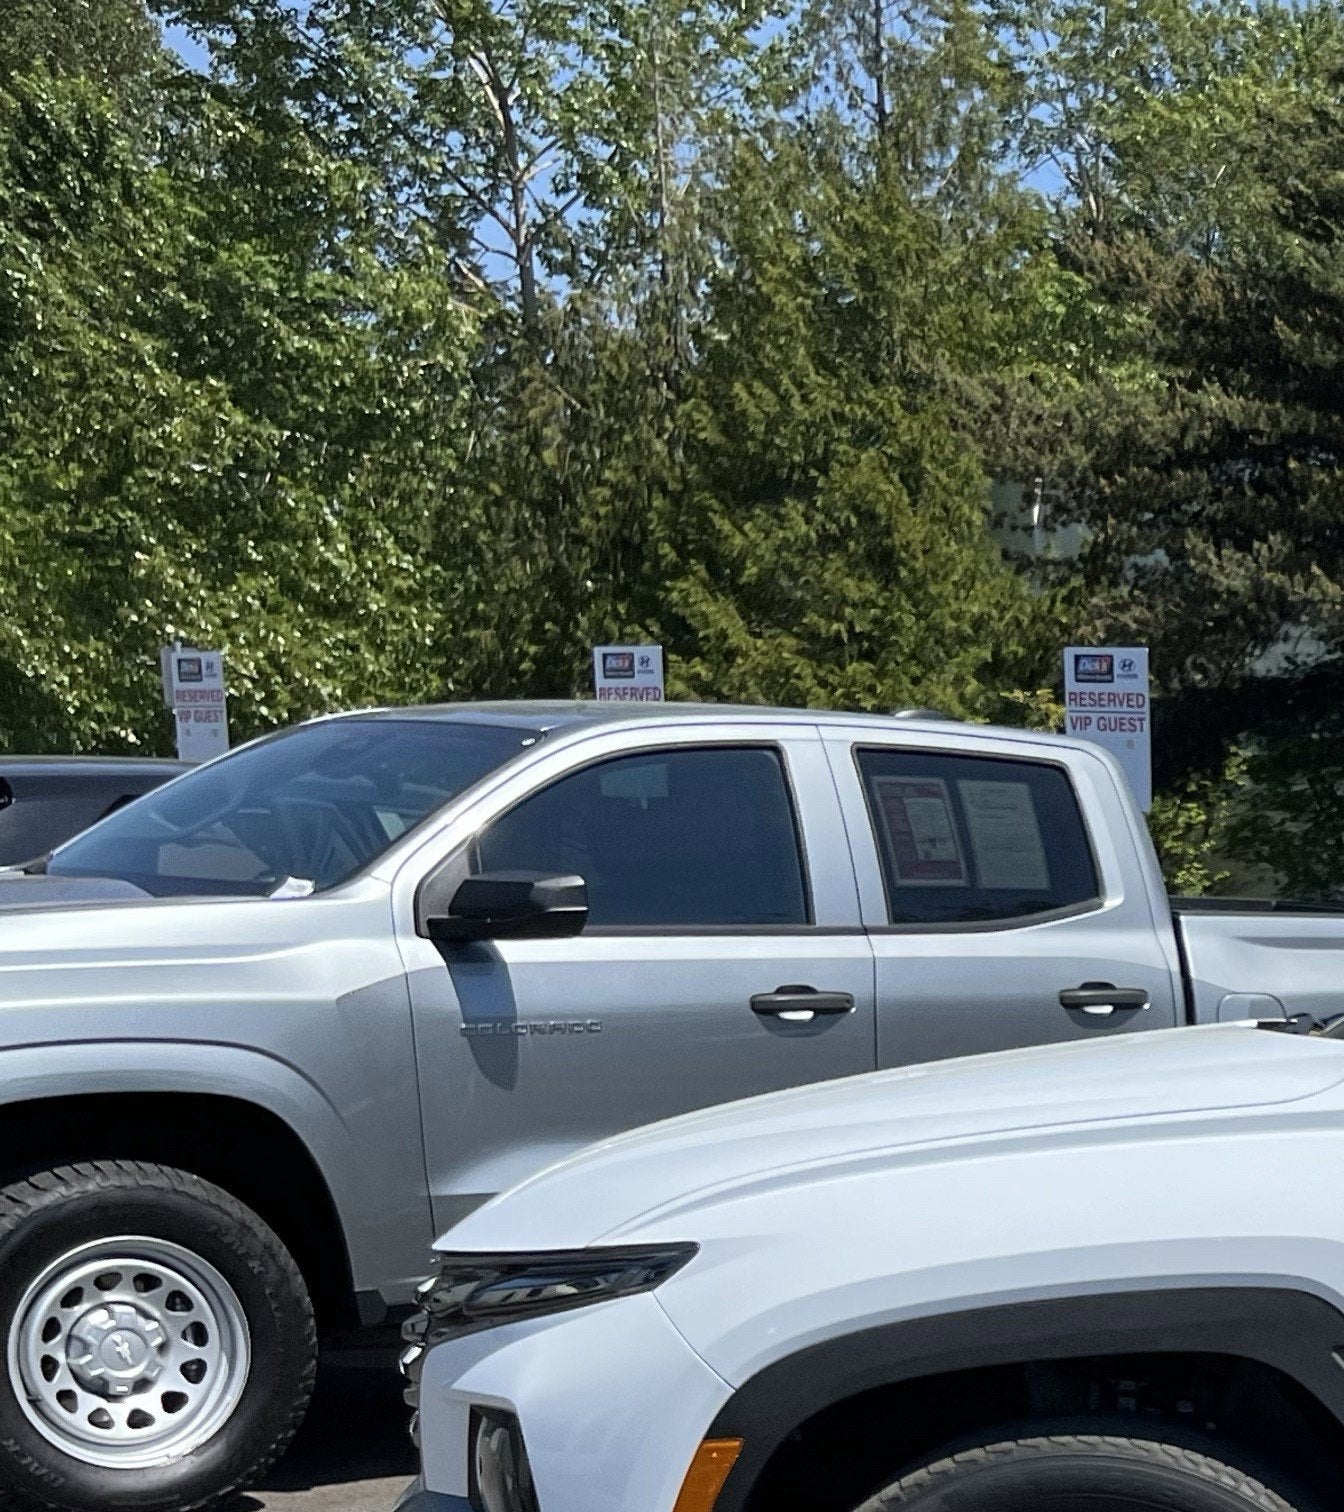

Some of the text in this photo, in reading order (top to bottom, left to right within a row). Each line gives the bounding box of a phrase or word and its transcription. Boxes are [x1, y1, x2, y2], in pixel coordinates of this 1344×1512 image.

[175, 688, 224, 703] RESERVED
[599, 686, 662, 700] RESERVED
[1068, 691, 1146, 709] RESERVED
[194, 708, 224, 723] GUEST
[1070, 715, 1146, 733] VIP GUEST
